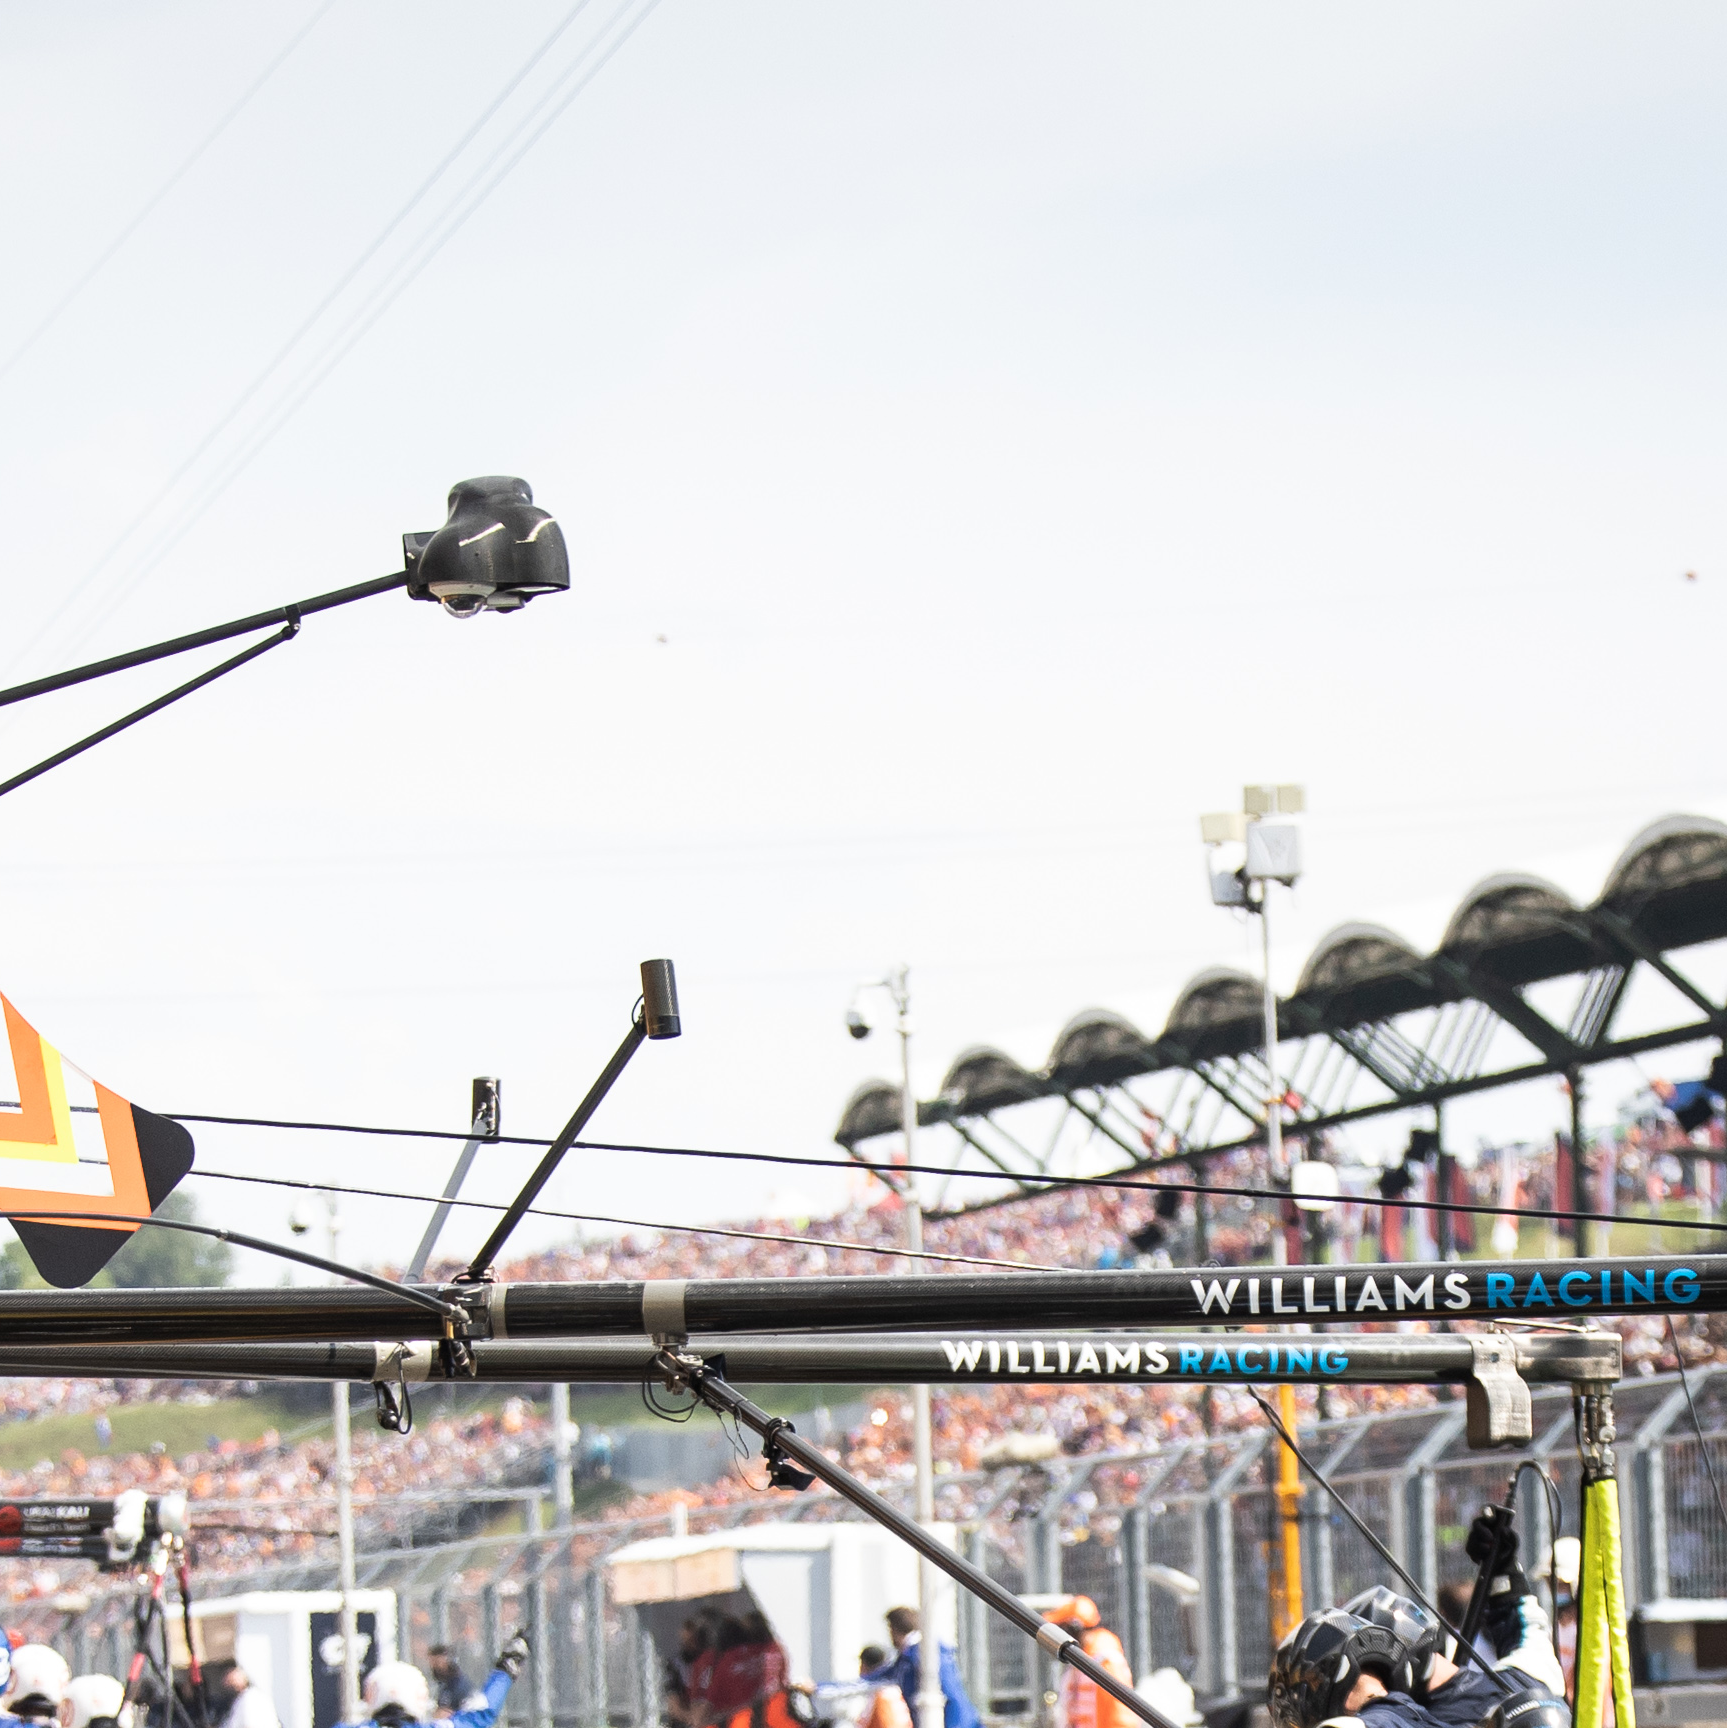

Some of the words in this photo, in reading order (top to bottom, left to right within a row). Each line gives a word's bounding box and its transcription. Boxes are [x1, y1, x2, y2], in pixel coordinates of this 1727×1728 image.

[1190, 1272, 1472, 1316] WILLIAMS
[1486, 1267, 1702, 1309] RACING
[941, 1341, 1170, 1373] WILLIAMS
[1179, 1342, 1349, 1374] RACING
